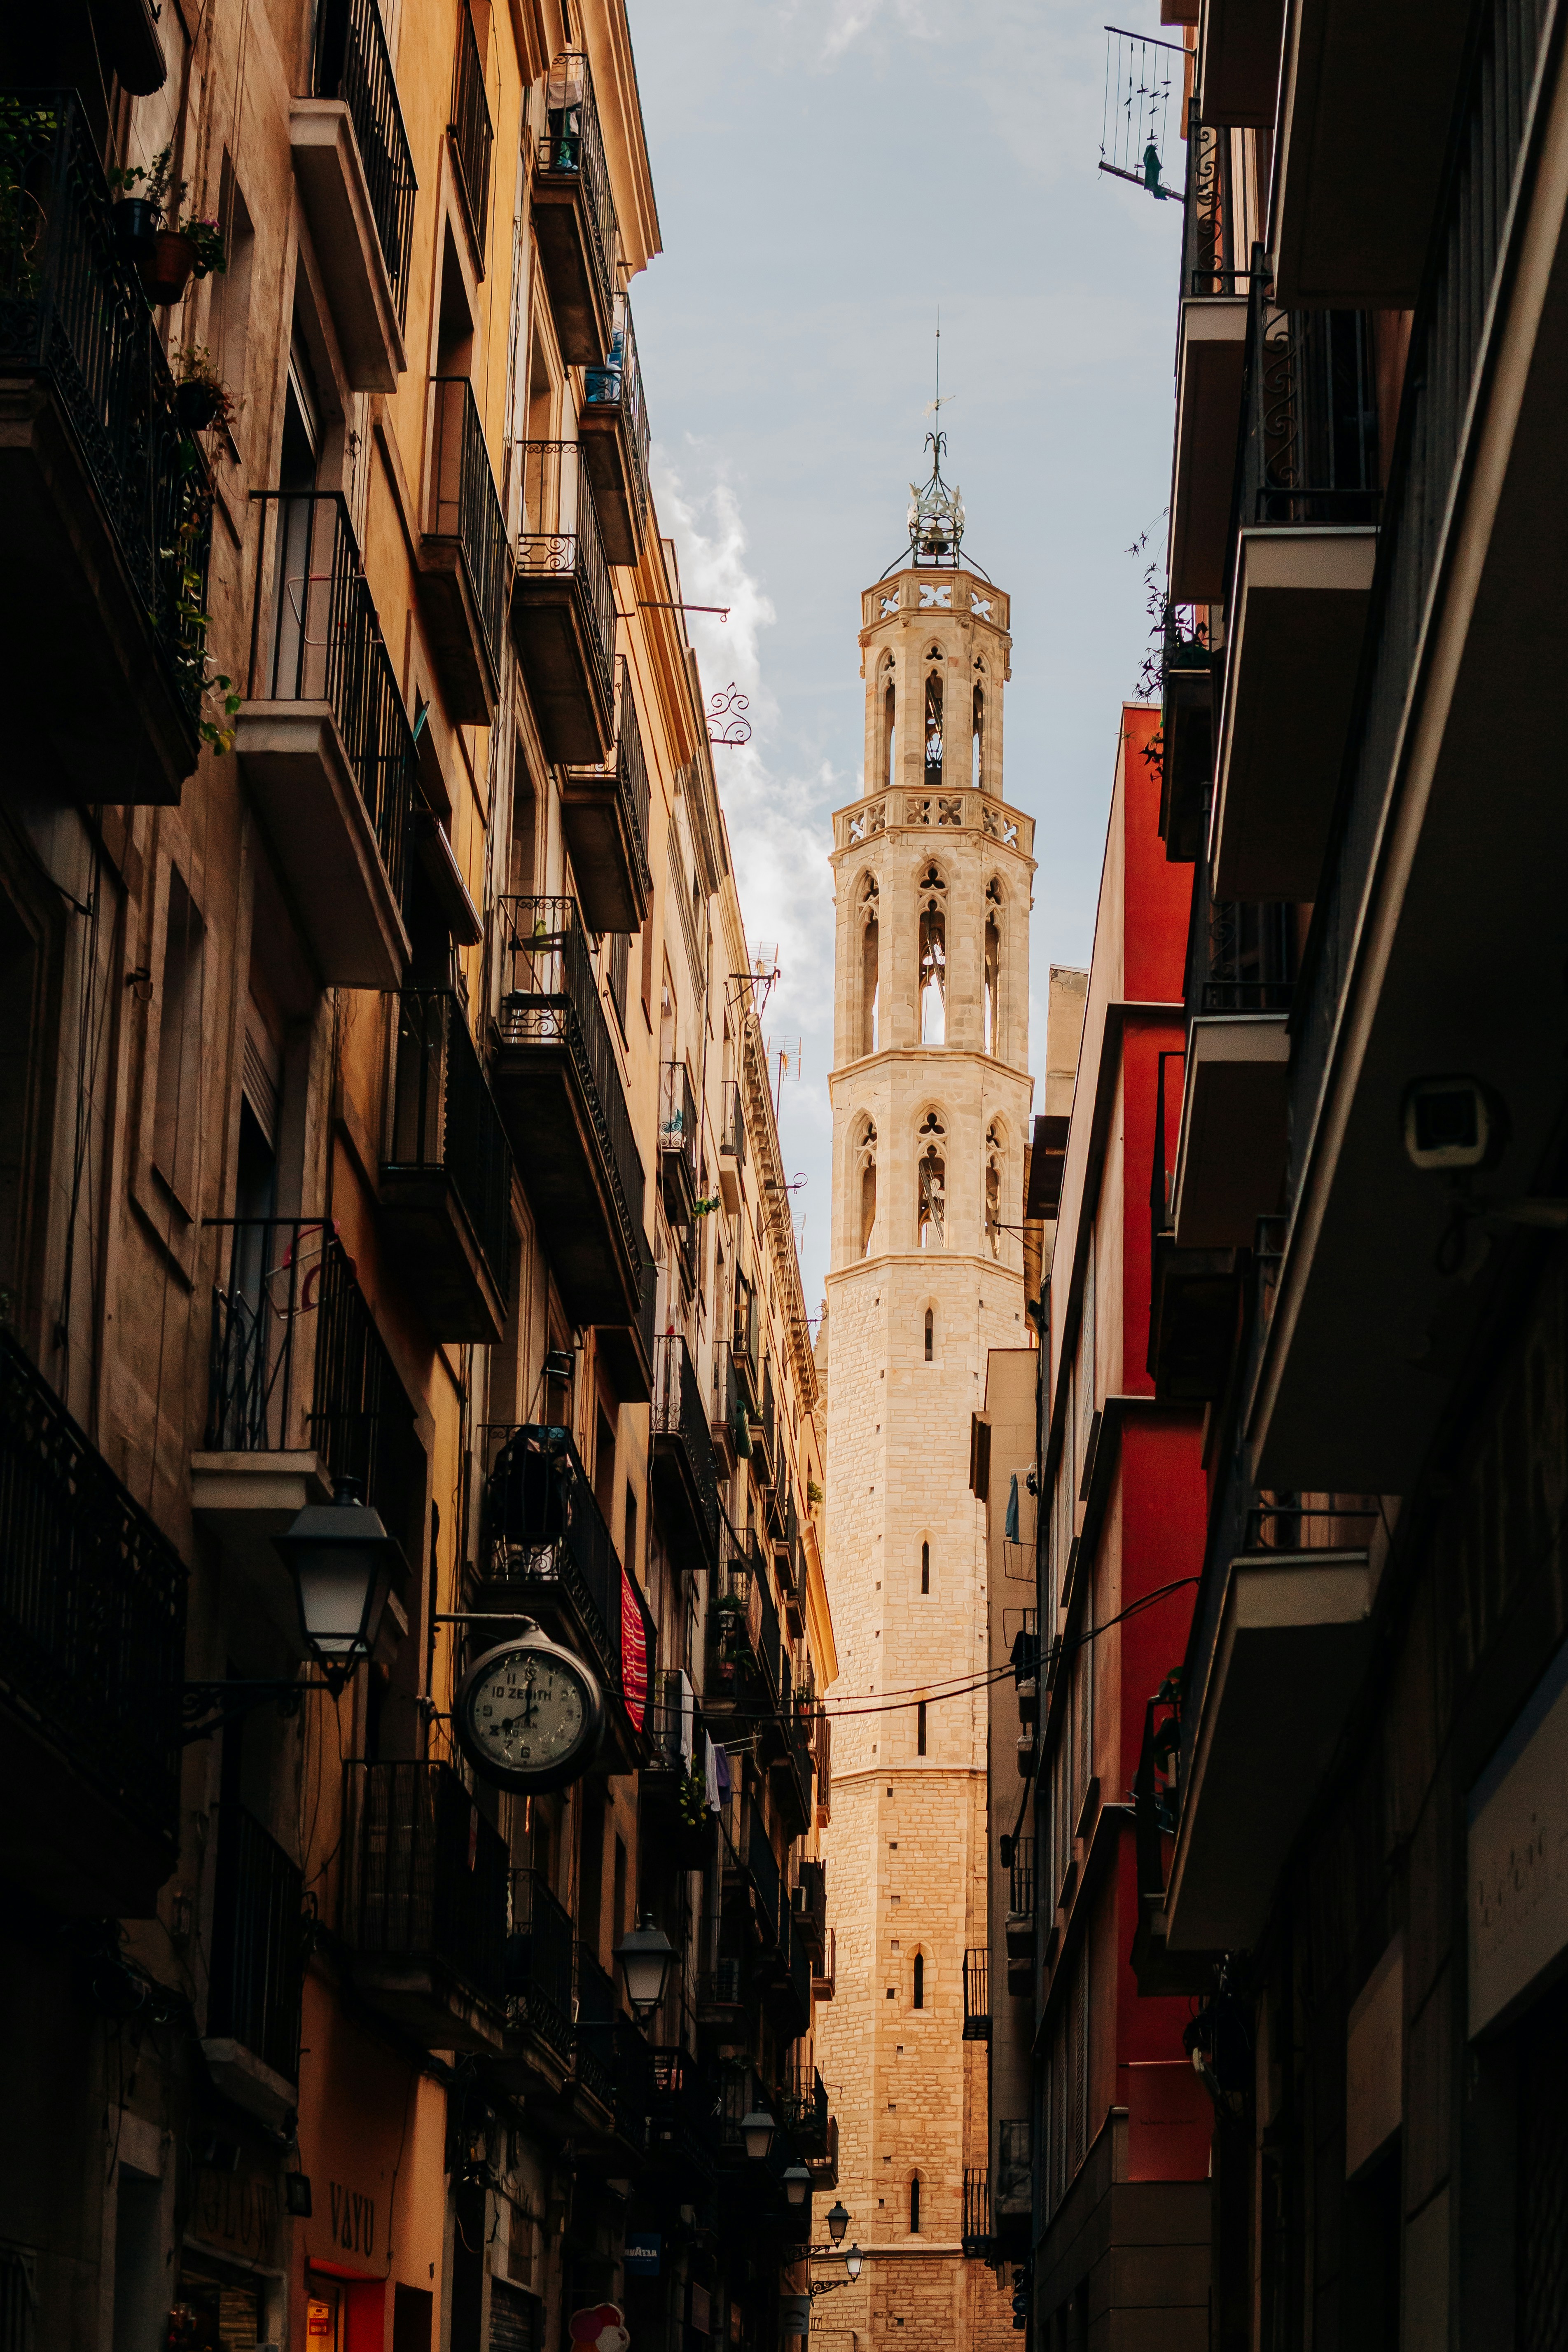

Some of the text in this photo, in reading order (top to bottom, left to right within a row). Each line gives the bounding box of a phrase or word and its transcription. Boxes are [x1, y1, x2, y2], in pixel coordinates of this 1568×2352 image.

[492, 1686, 505, 1698] 10
[508, 1688, 552, 1701] ZEITH
[489, 1725, 499, 1736] 8
[503, 1740, 513, 1750] 7
[624, 2247, 657, 2257] AVAZZA
